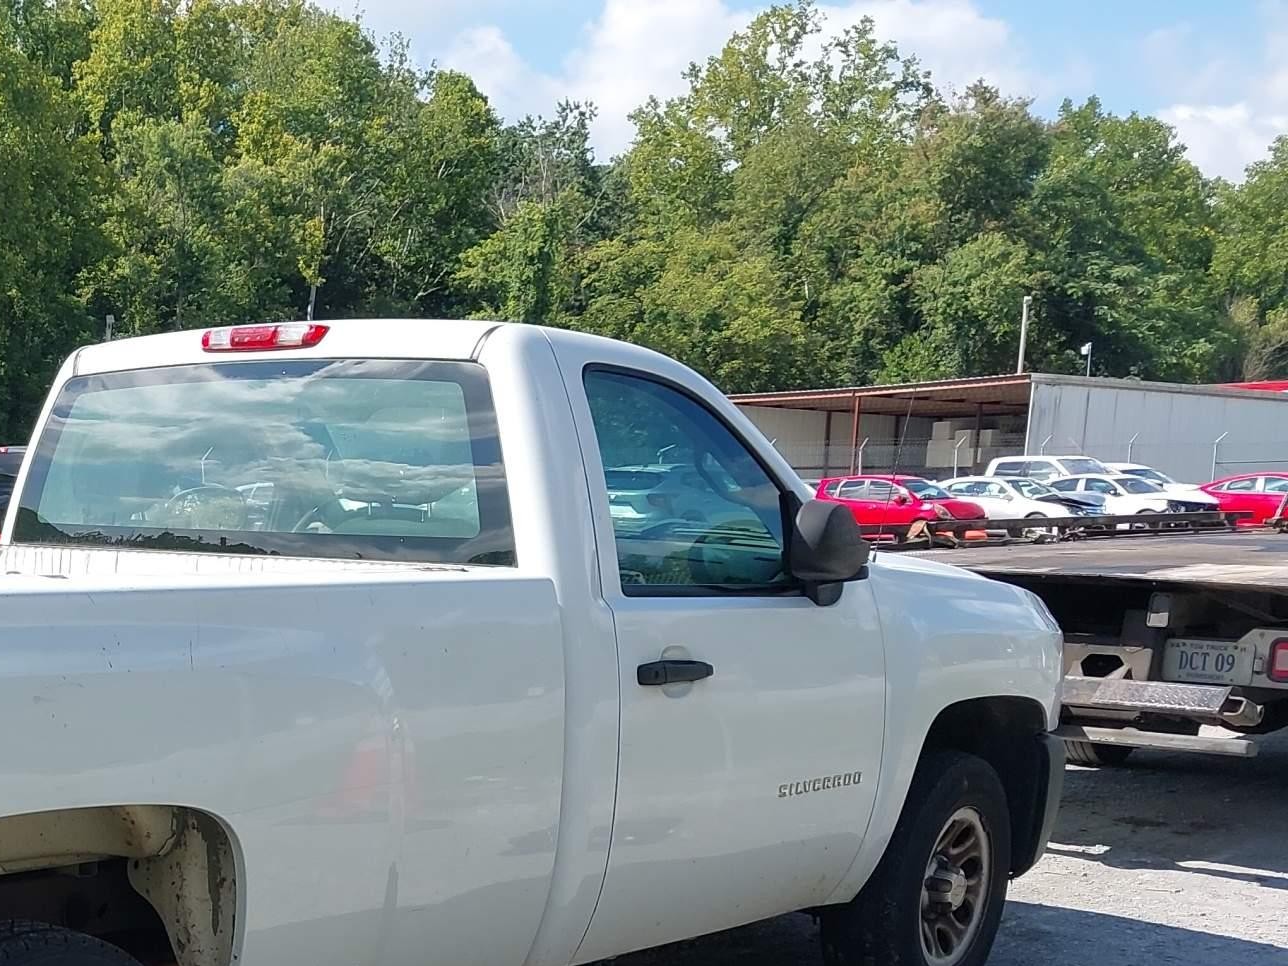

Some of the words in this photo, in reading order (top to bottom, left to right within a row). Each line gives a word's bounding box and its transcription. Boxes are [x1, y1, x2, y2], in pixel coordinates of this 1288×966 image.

[1178, 651, 1210, 671] DCT
[1215, 653, 1236, 673] 09
[778, 771, 863, 798] SILVERADO
